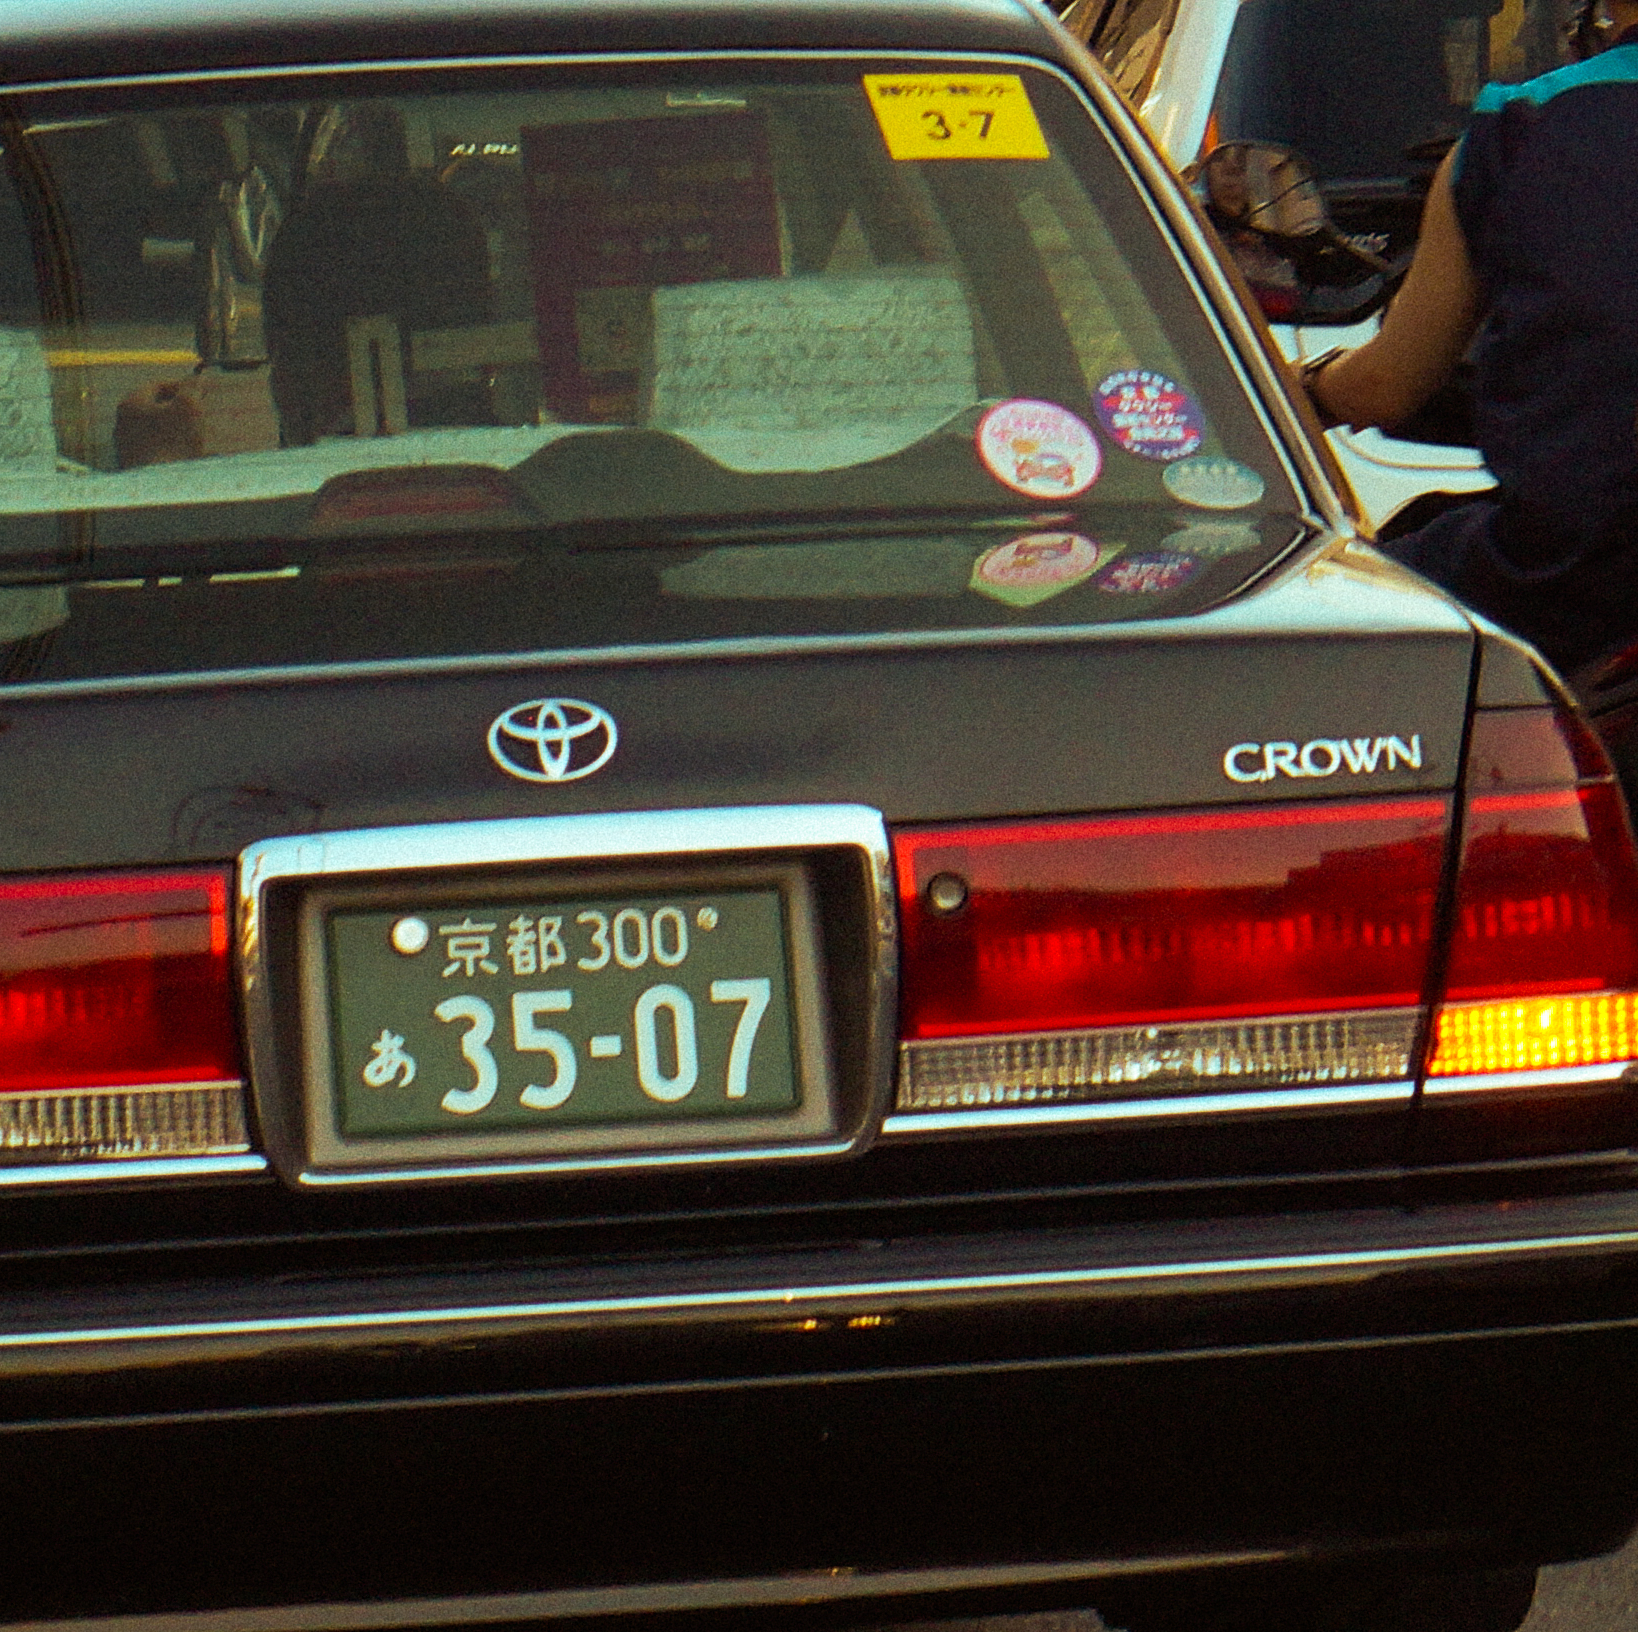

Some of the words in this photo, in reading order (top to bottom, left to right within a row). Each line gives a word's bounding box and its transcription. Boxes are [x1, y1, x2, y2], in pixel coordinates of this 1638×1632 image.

[1223, 734, 1422, 783] CROWN
[362, 1029, 417, 1088] あ
[434, 977, 771, 1115] 35-07
